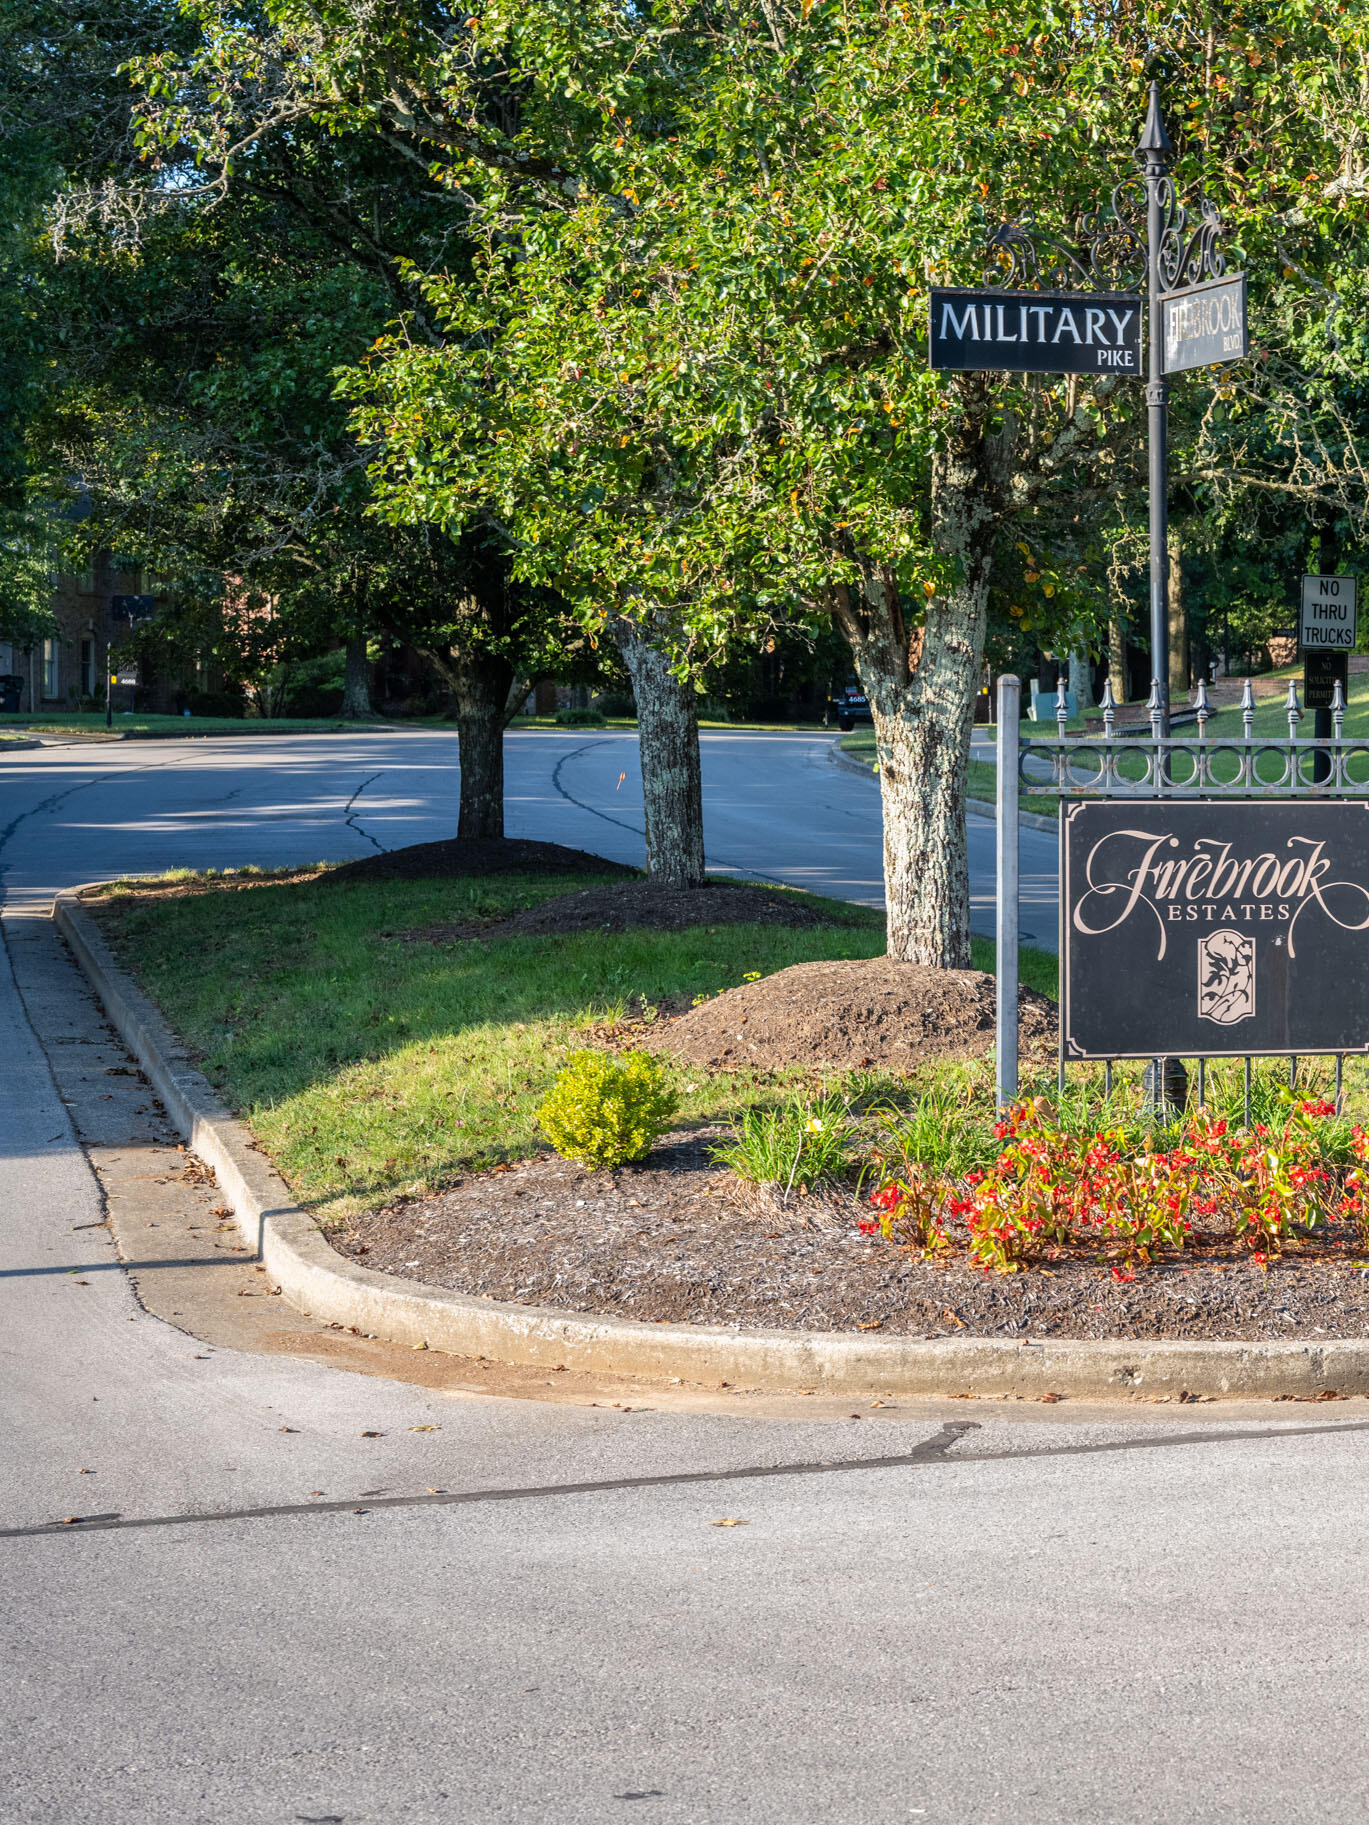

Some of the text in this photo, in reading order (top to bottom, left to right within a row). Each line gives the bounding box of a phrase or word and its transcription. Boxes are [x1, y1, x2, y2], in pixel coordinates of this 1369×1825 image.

[939, 302, 1134, 346] MILITARY
[1097, 349, 1134, 367] PIKE
[1320, 580, 1340, 597] NO
[1311, 603, 1347, 621] THRU
[1304, 626, 1352, 645] TRUCKS
[1320, 661, 1332, 671] NO
[1167, 903, 1290, 922] ESTATES
